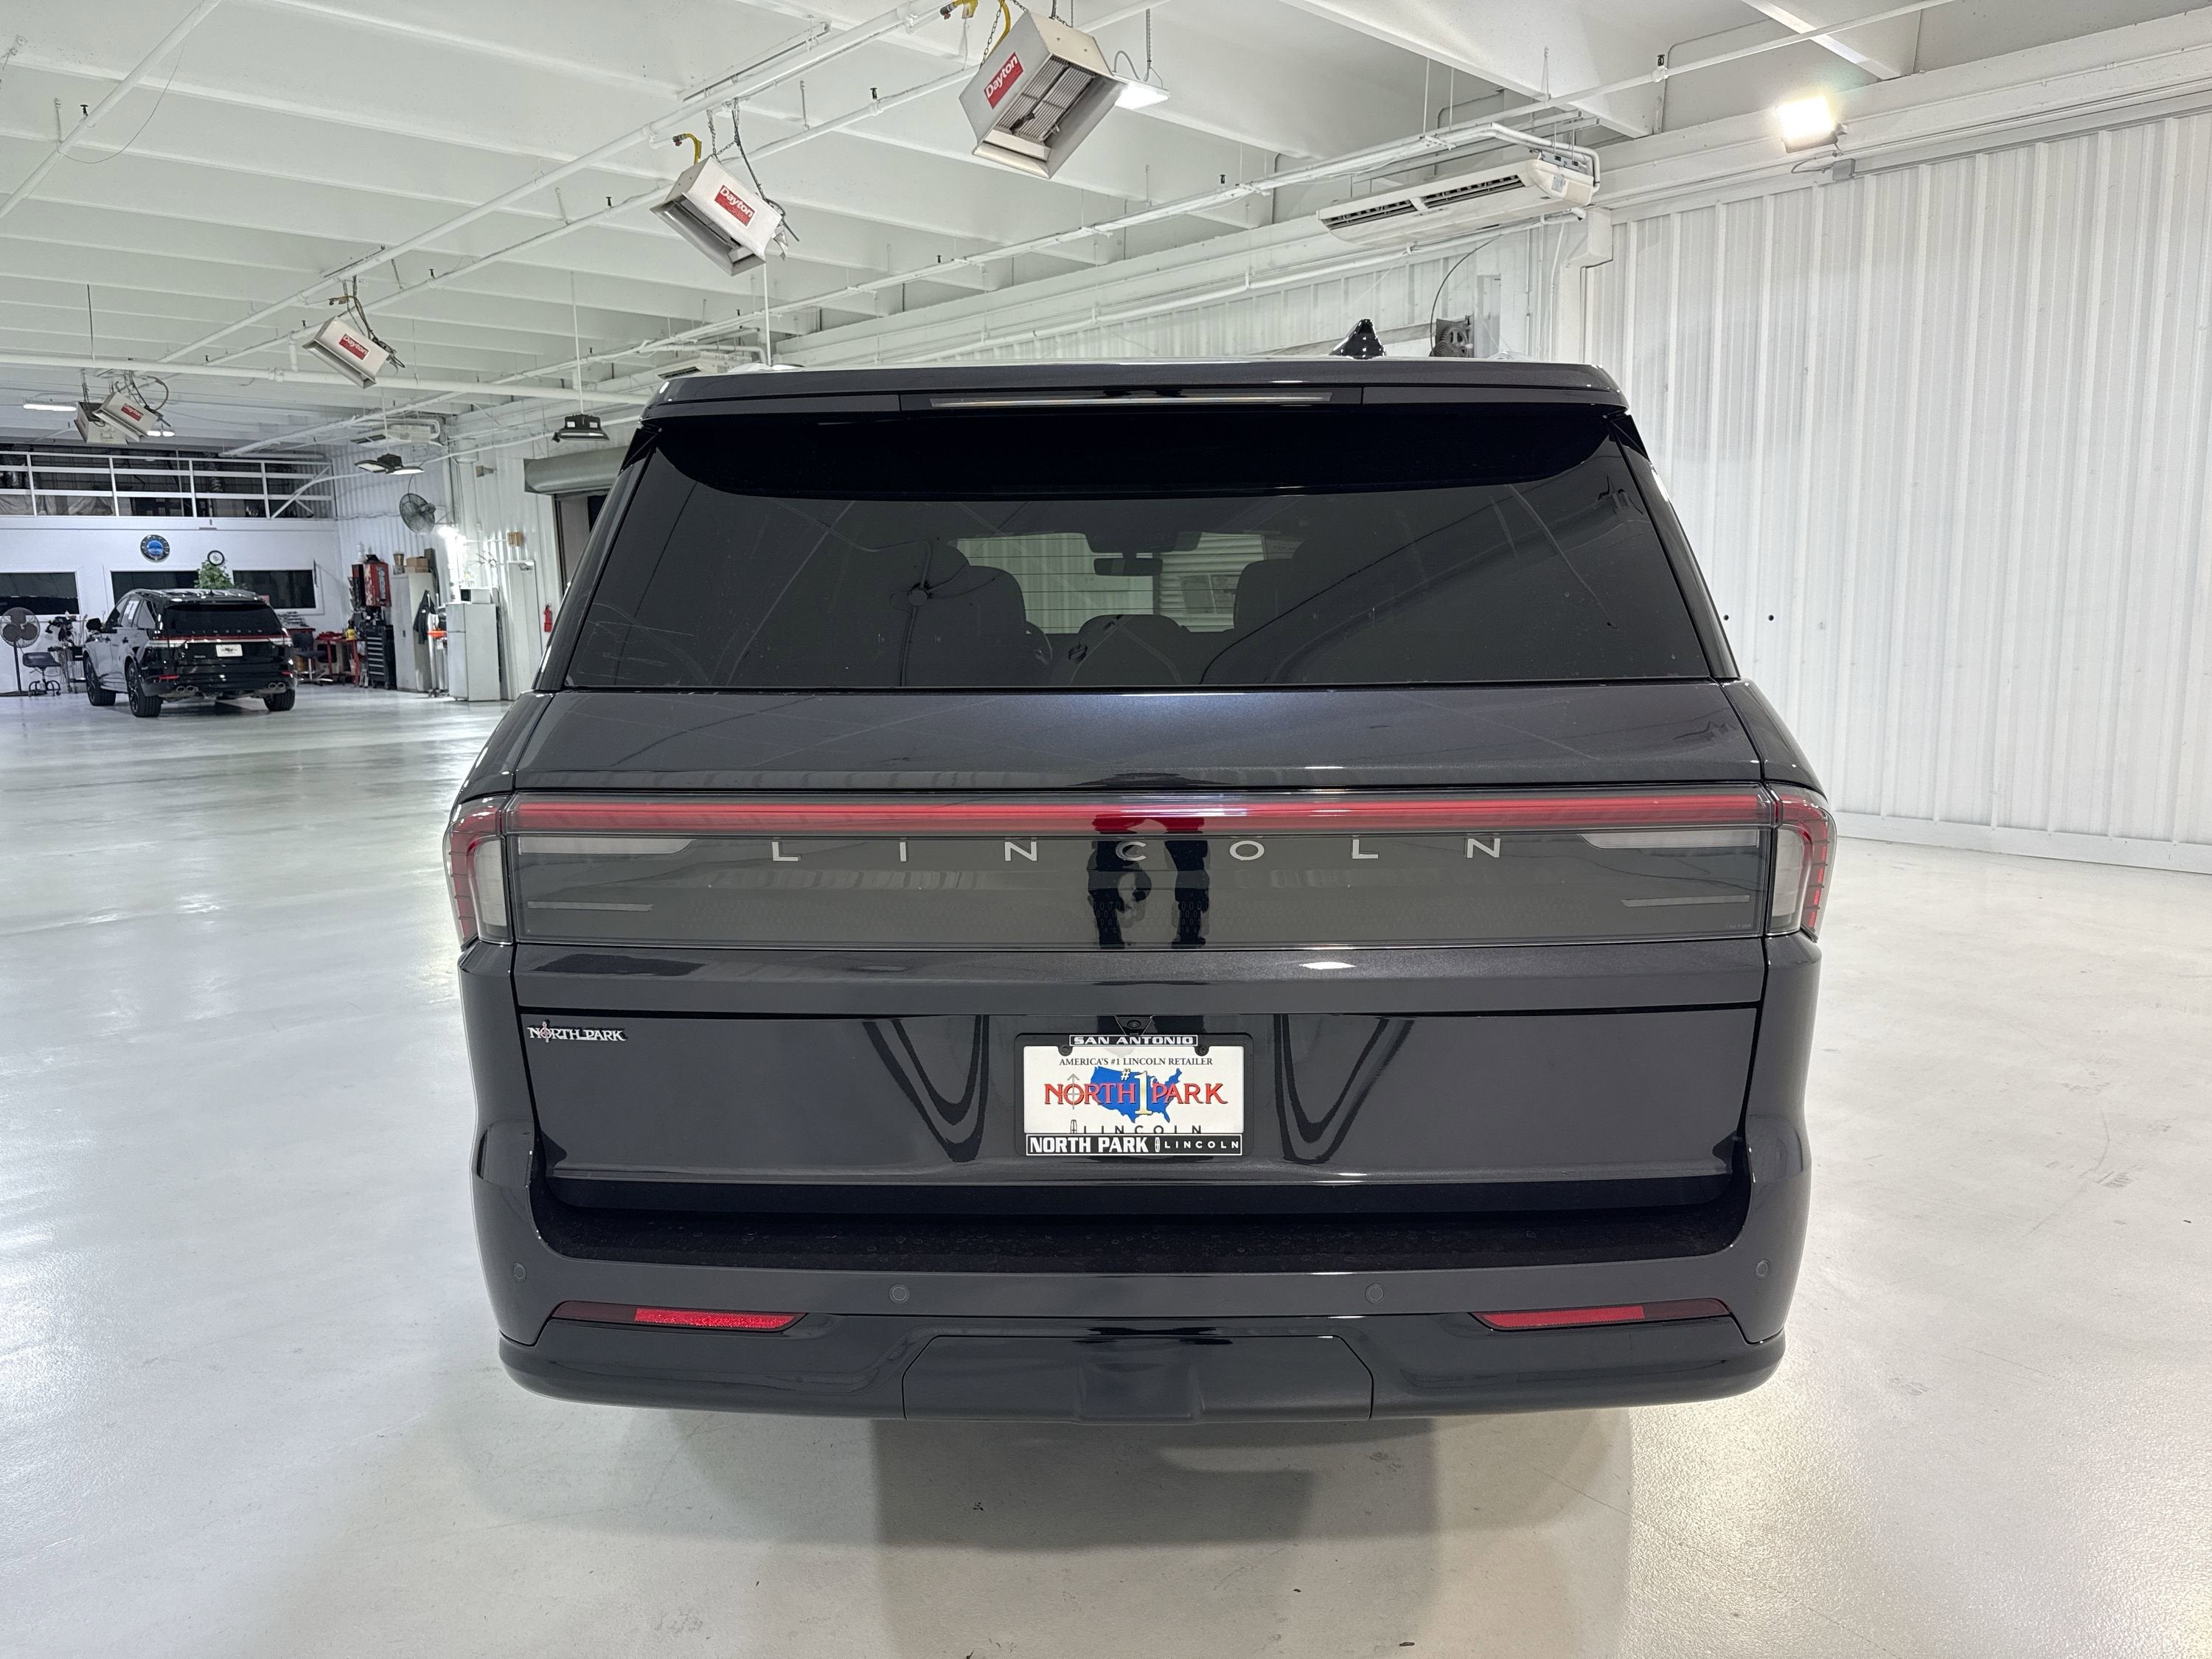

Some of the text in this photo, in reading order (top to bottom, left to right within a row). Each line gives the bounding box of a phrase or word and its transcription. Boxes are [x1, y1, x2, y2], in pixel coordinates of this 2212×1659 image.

[985, 55, 1018, 99] Dayton
[720, 187, 754, 219] Dayton
[343, 335, 368, 355] Dayton
[771, 838, 1501, 863] LINCOLN
[527, 1026, 626, 1042] NORTH PARK
[1074, 1036, 1194, 1045] SAN ANTONIO
[1059, 1057, 1214, 1066] AMERICA'S #1 LINCOLN RETAILER
[1044, 1082, 1229, 1106] NORTH PARK
[1029, 1136, 1239, 1153] NORTH PARK LINCOLN
